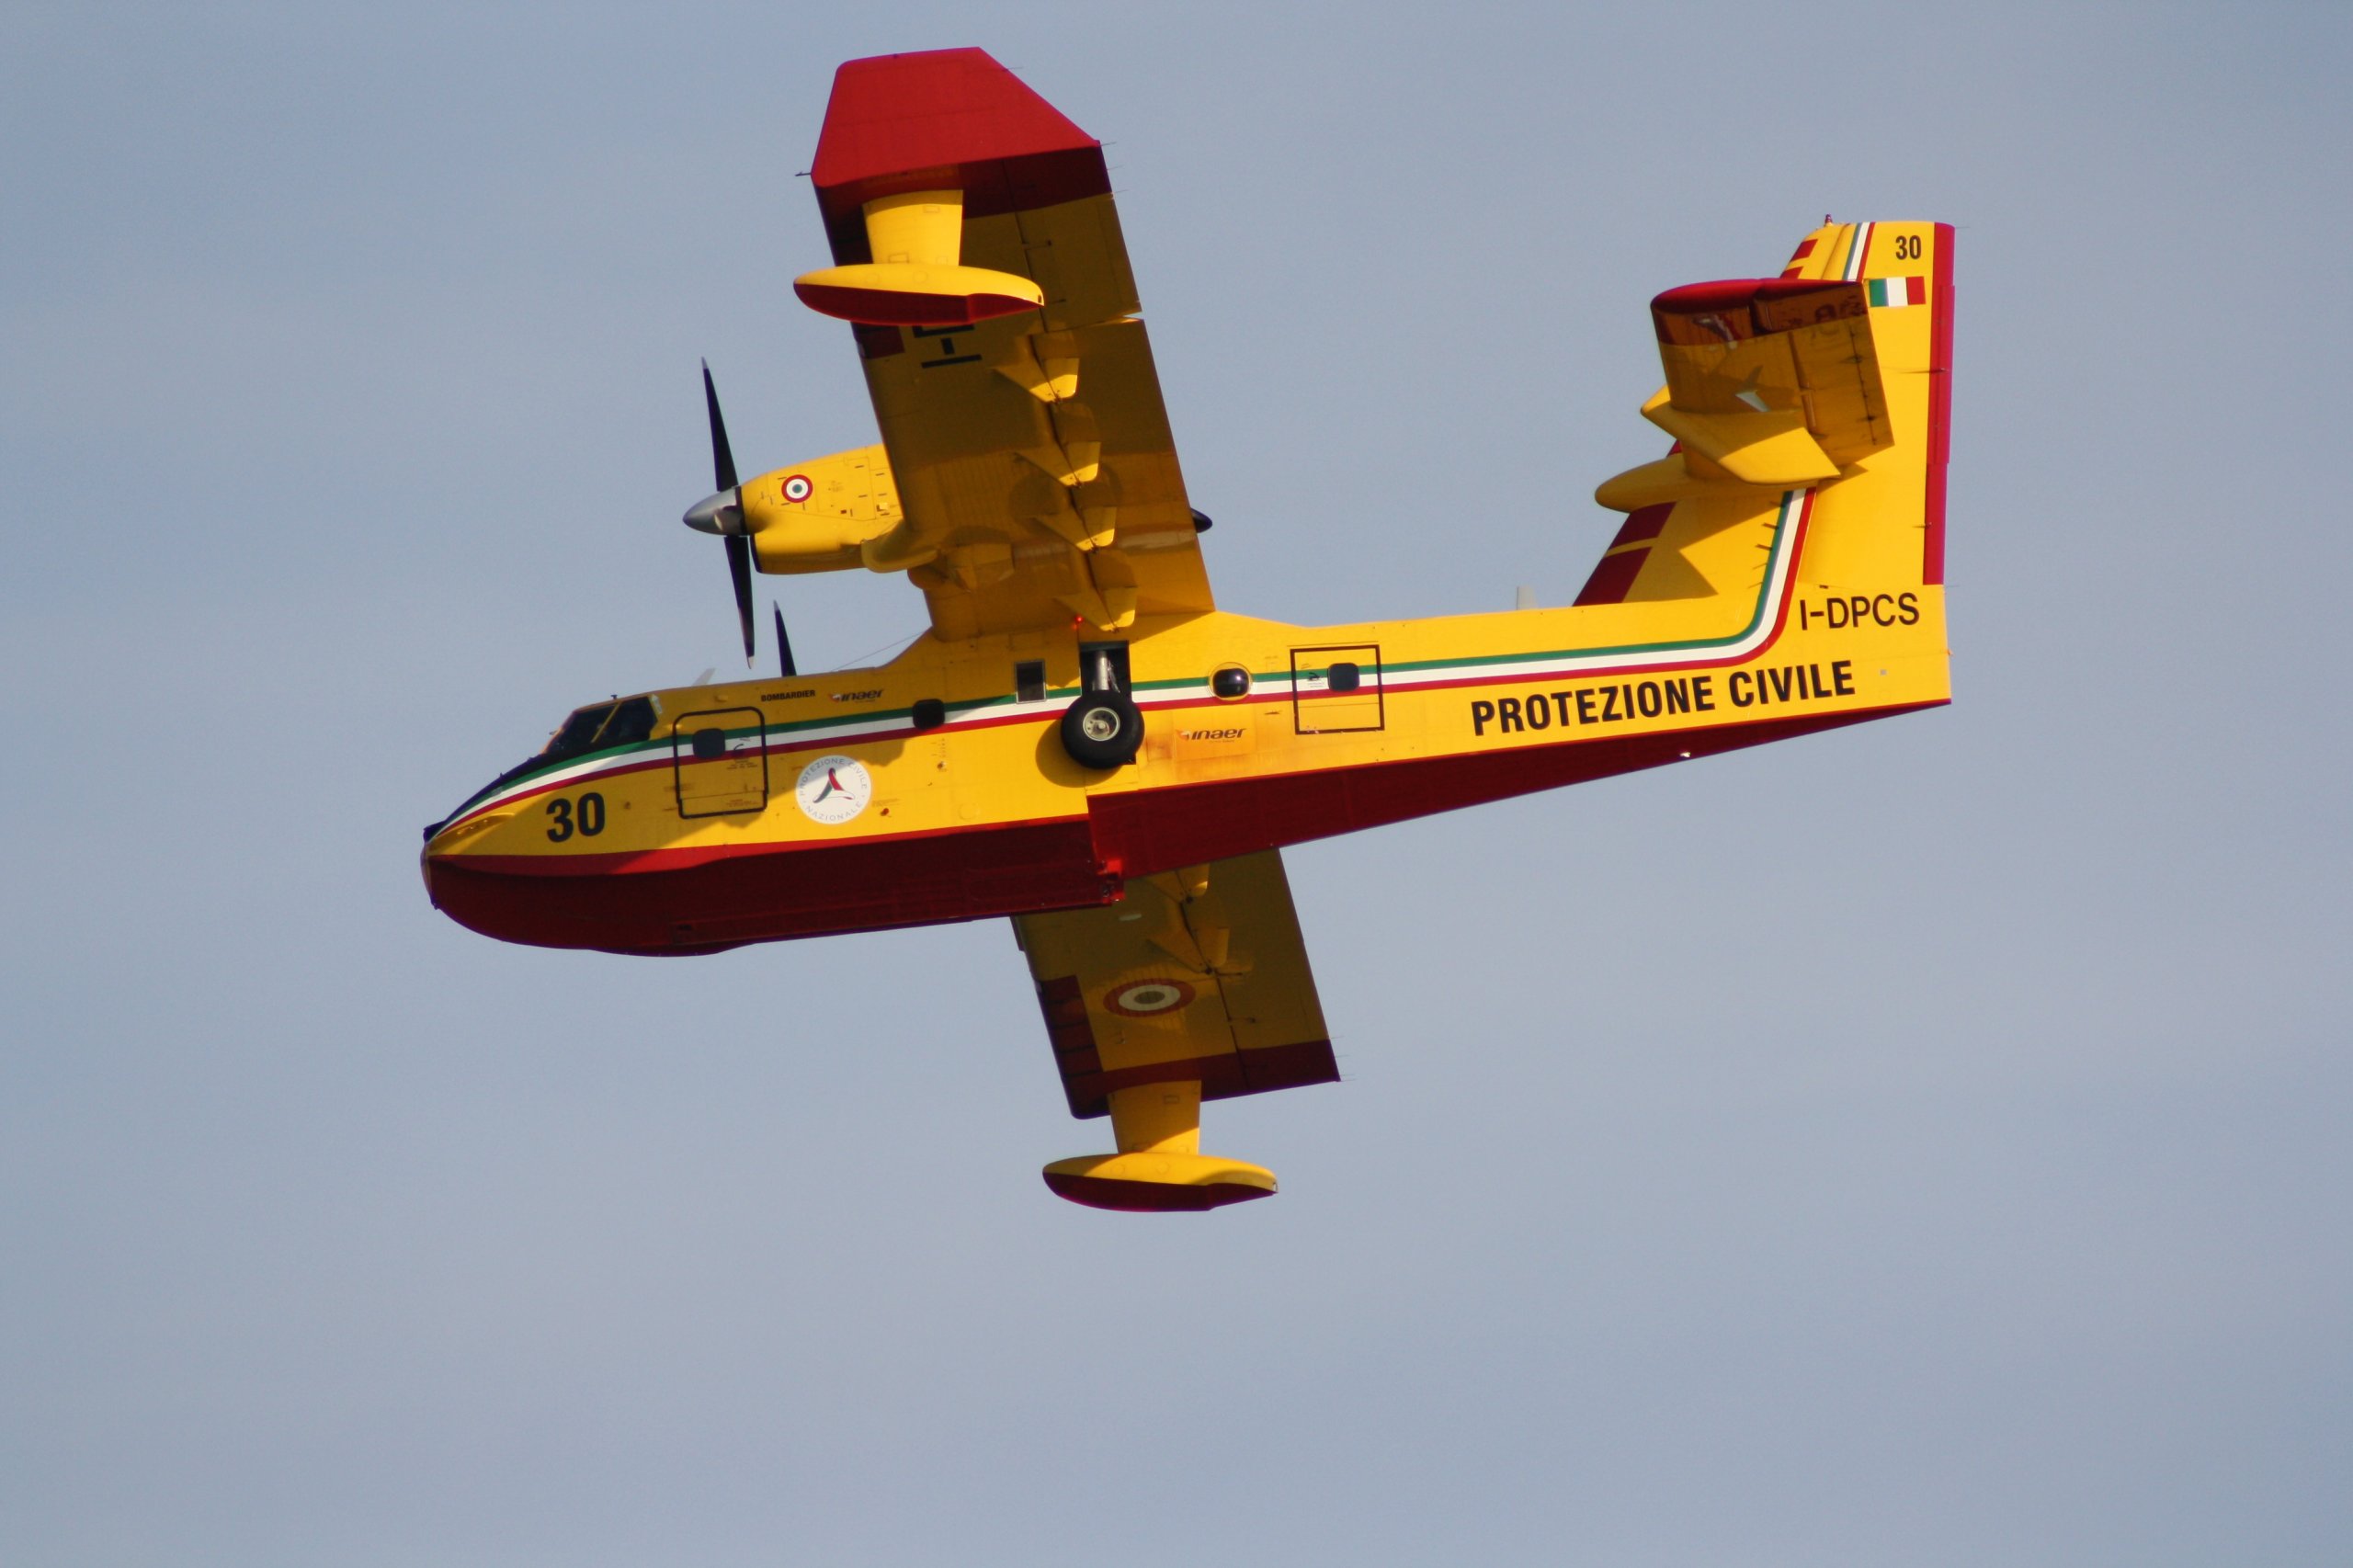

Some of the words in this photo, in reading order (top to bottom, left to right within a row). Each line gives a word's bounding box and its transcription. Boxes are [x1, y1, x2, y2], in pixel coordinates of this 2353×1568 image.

[1895, 234, 1922, 261] 30
[1800, 592, 1921, 631] I-DPCS
[760, 689, 816, 702] BOMBARDIER
[1471, 676, 1716, 737] PROTEZIONE
[1729, 660, 1856, 704] CIVILE
[800, 757, 846, 796] PROTEZIONE
[847, 761, 868, 790] CIVILE
[546, 791, 607, 843] 30
[805, 801, 862, 822] NAZIONALE
